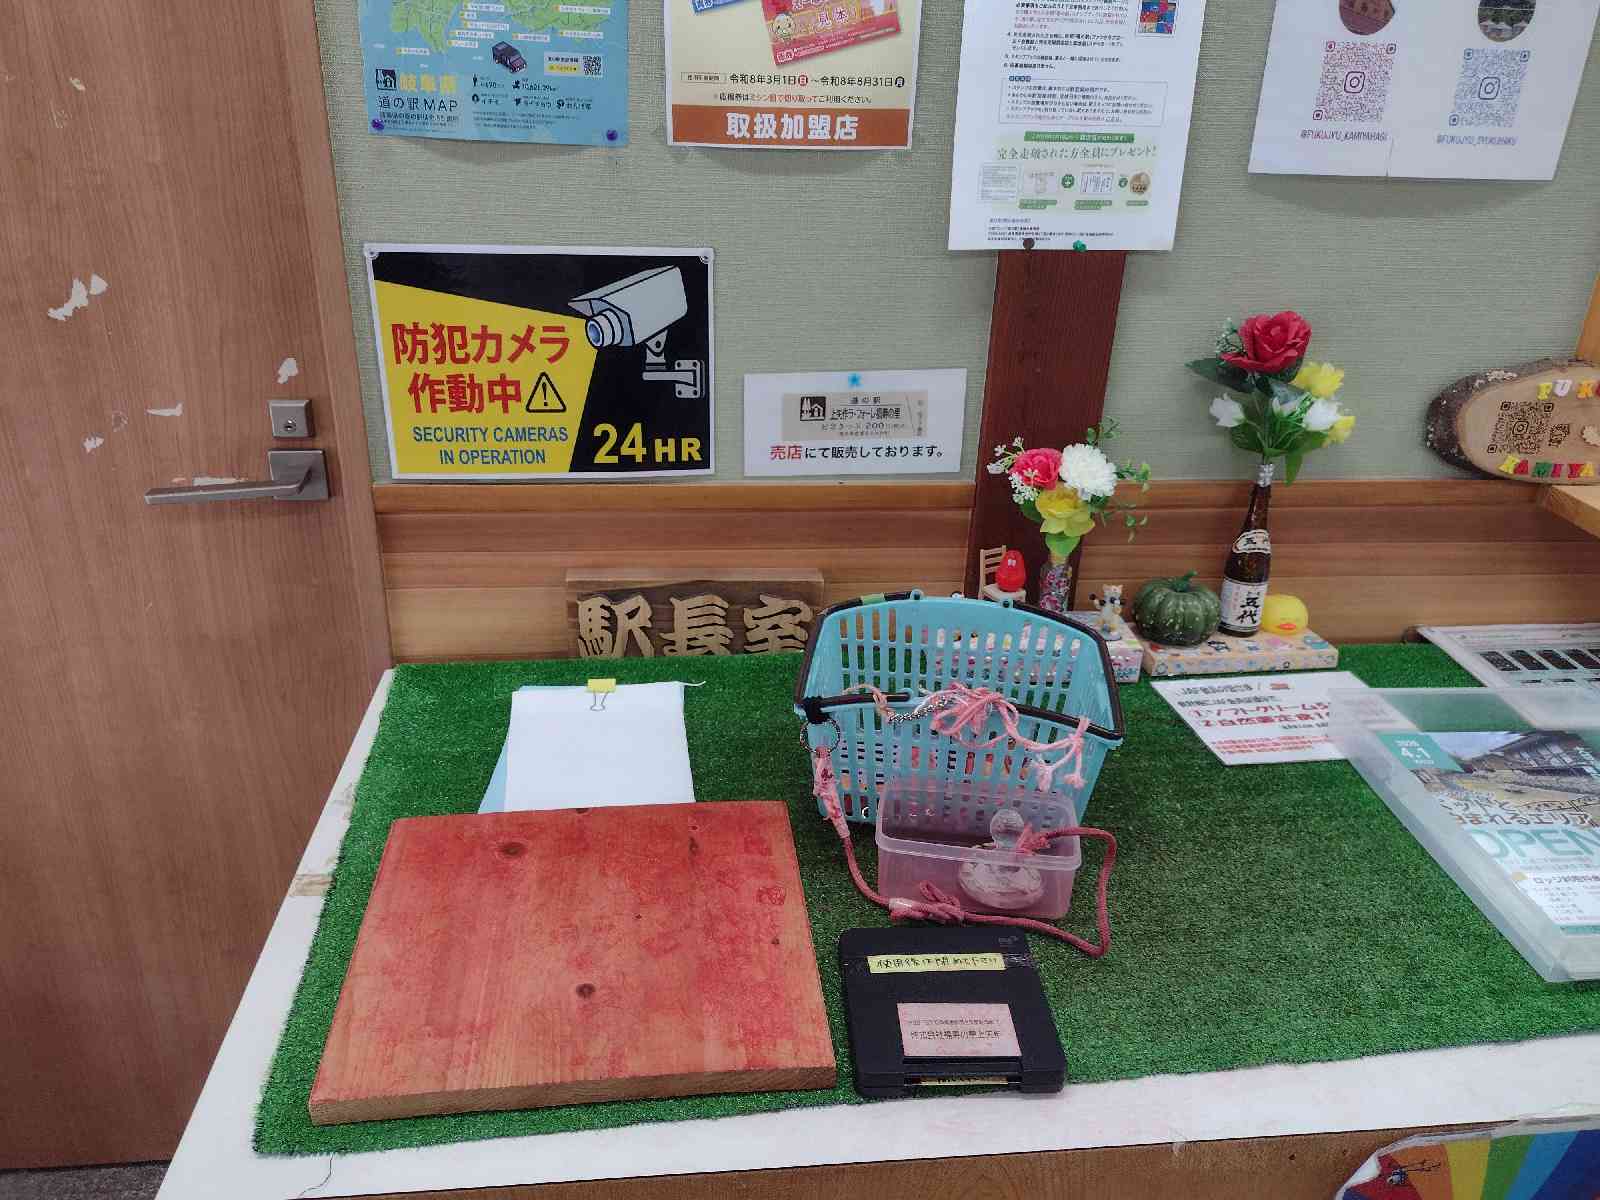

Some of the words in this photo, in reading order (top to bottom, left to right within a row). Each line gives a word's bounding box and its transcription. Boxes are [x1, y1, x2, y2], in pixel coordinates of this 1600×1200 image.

[423, 98, 458, 112] MAP
[725, 112, 859, 141] 取扱加盟店
[391, 322, 570, 365] 防犯カメラ
[408, 372, 522, 414] 作動中
[412, 427, 488, 443] SECURITY
[493, 426, 568, 442] CAMERAS
[593, 423, 646, 464] 24
[654, 436, 703, 463] HR
[439, 450, 455, 465] IN
[458, 449, 546, 465] OPERATION
